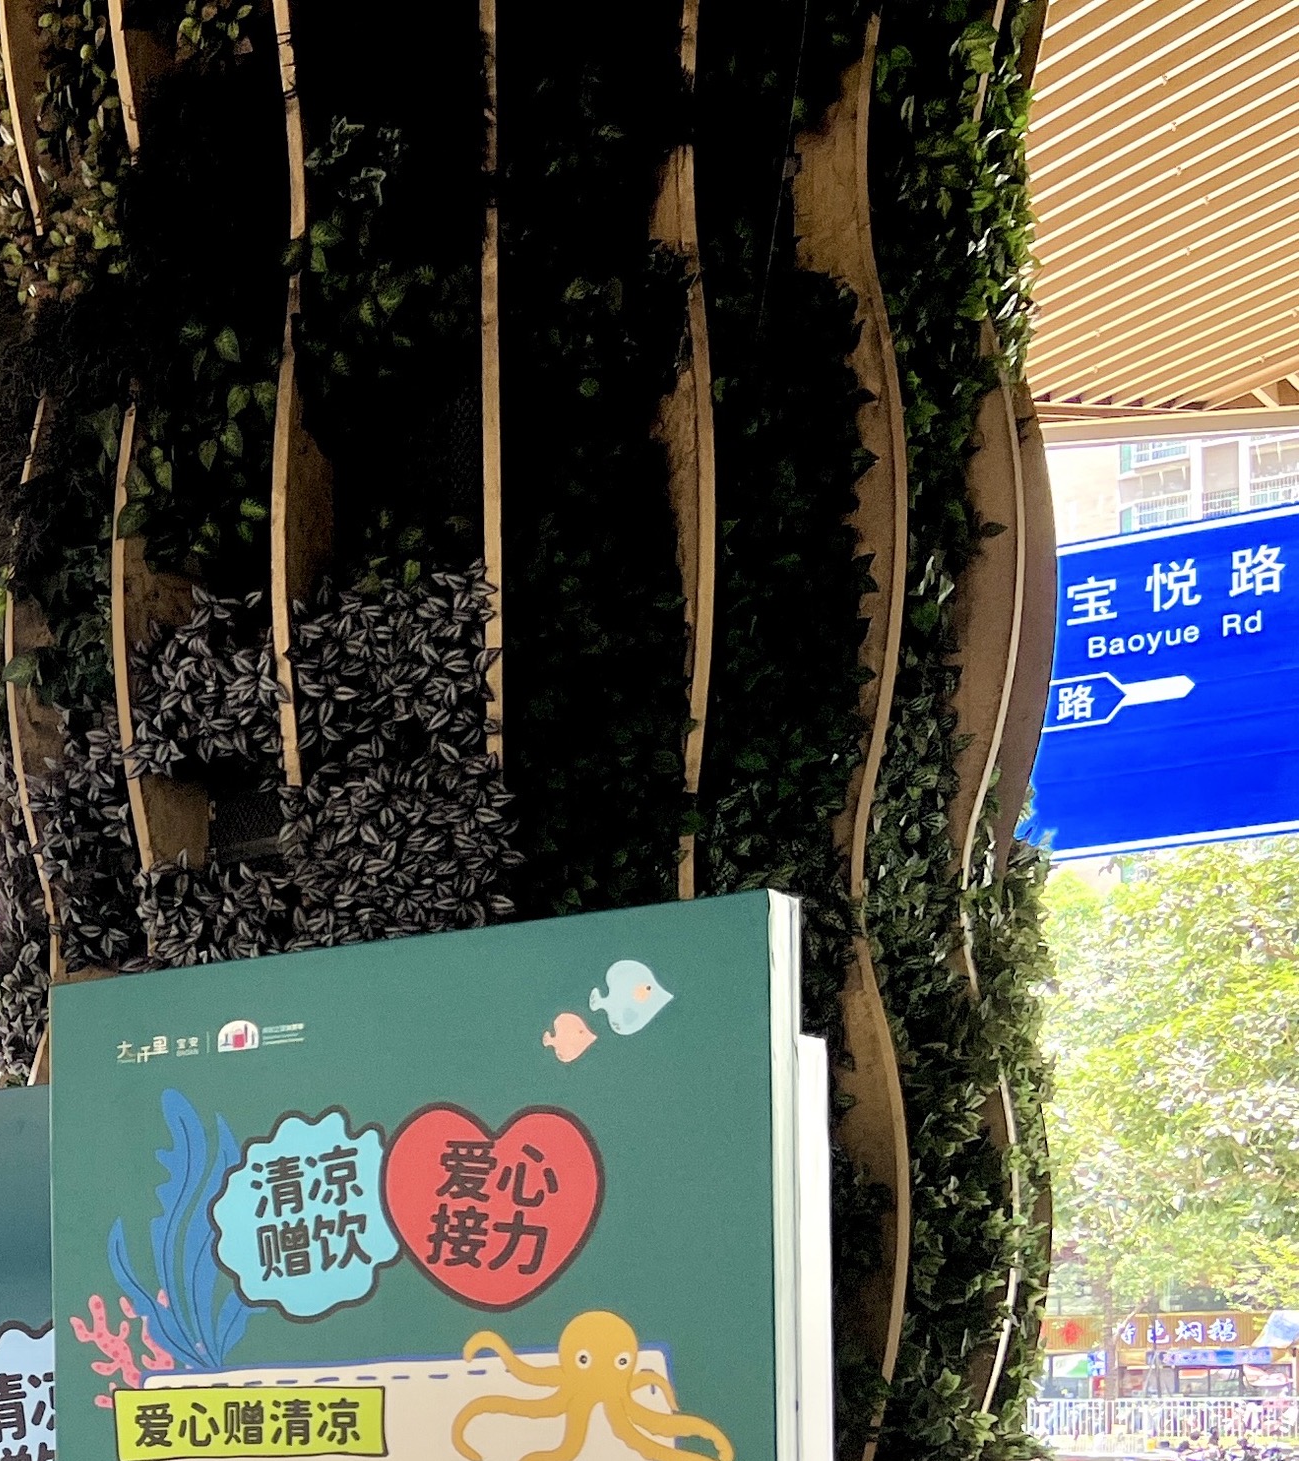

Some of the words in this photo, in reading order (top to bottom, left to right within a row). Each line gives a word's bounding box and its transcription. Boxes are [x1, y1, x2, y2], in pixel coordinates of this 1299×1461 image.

[1066, 544, 1286, 627] 宝悦路
[1087, 625, 1200, 659] Baoyue
[1222, 611, 1263, 637] Rd
[1056, 685, 1095, 721] 路
[250, 1146, 362, 1218] 清凉
[439, 1140, 557, 1207] 爱心
[257, 1211, 371, 1281] 赠饮
[426, 1204, 549, 1275] 接力
[134, 1398, 362, 1447] 爱心赠清凉
